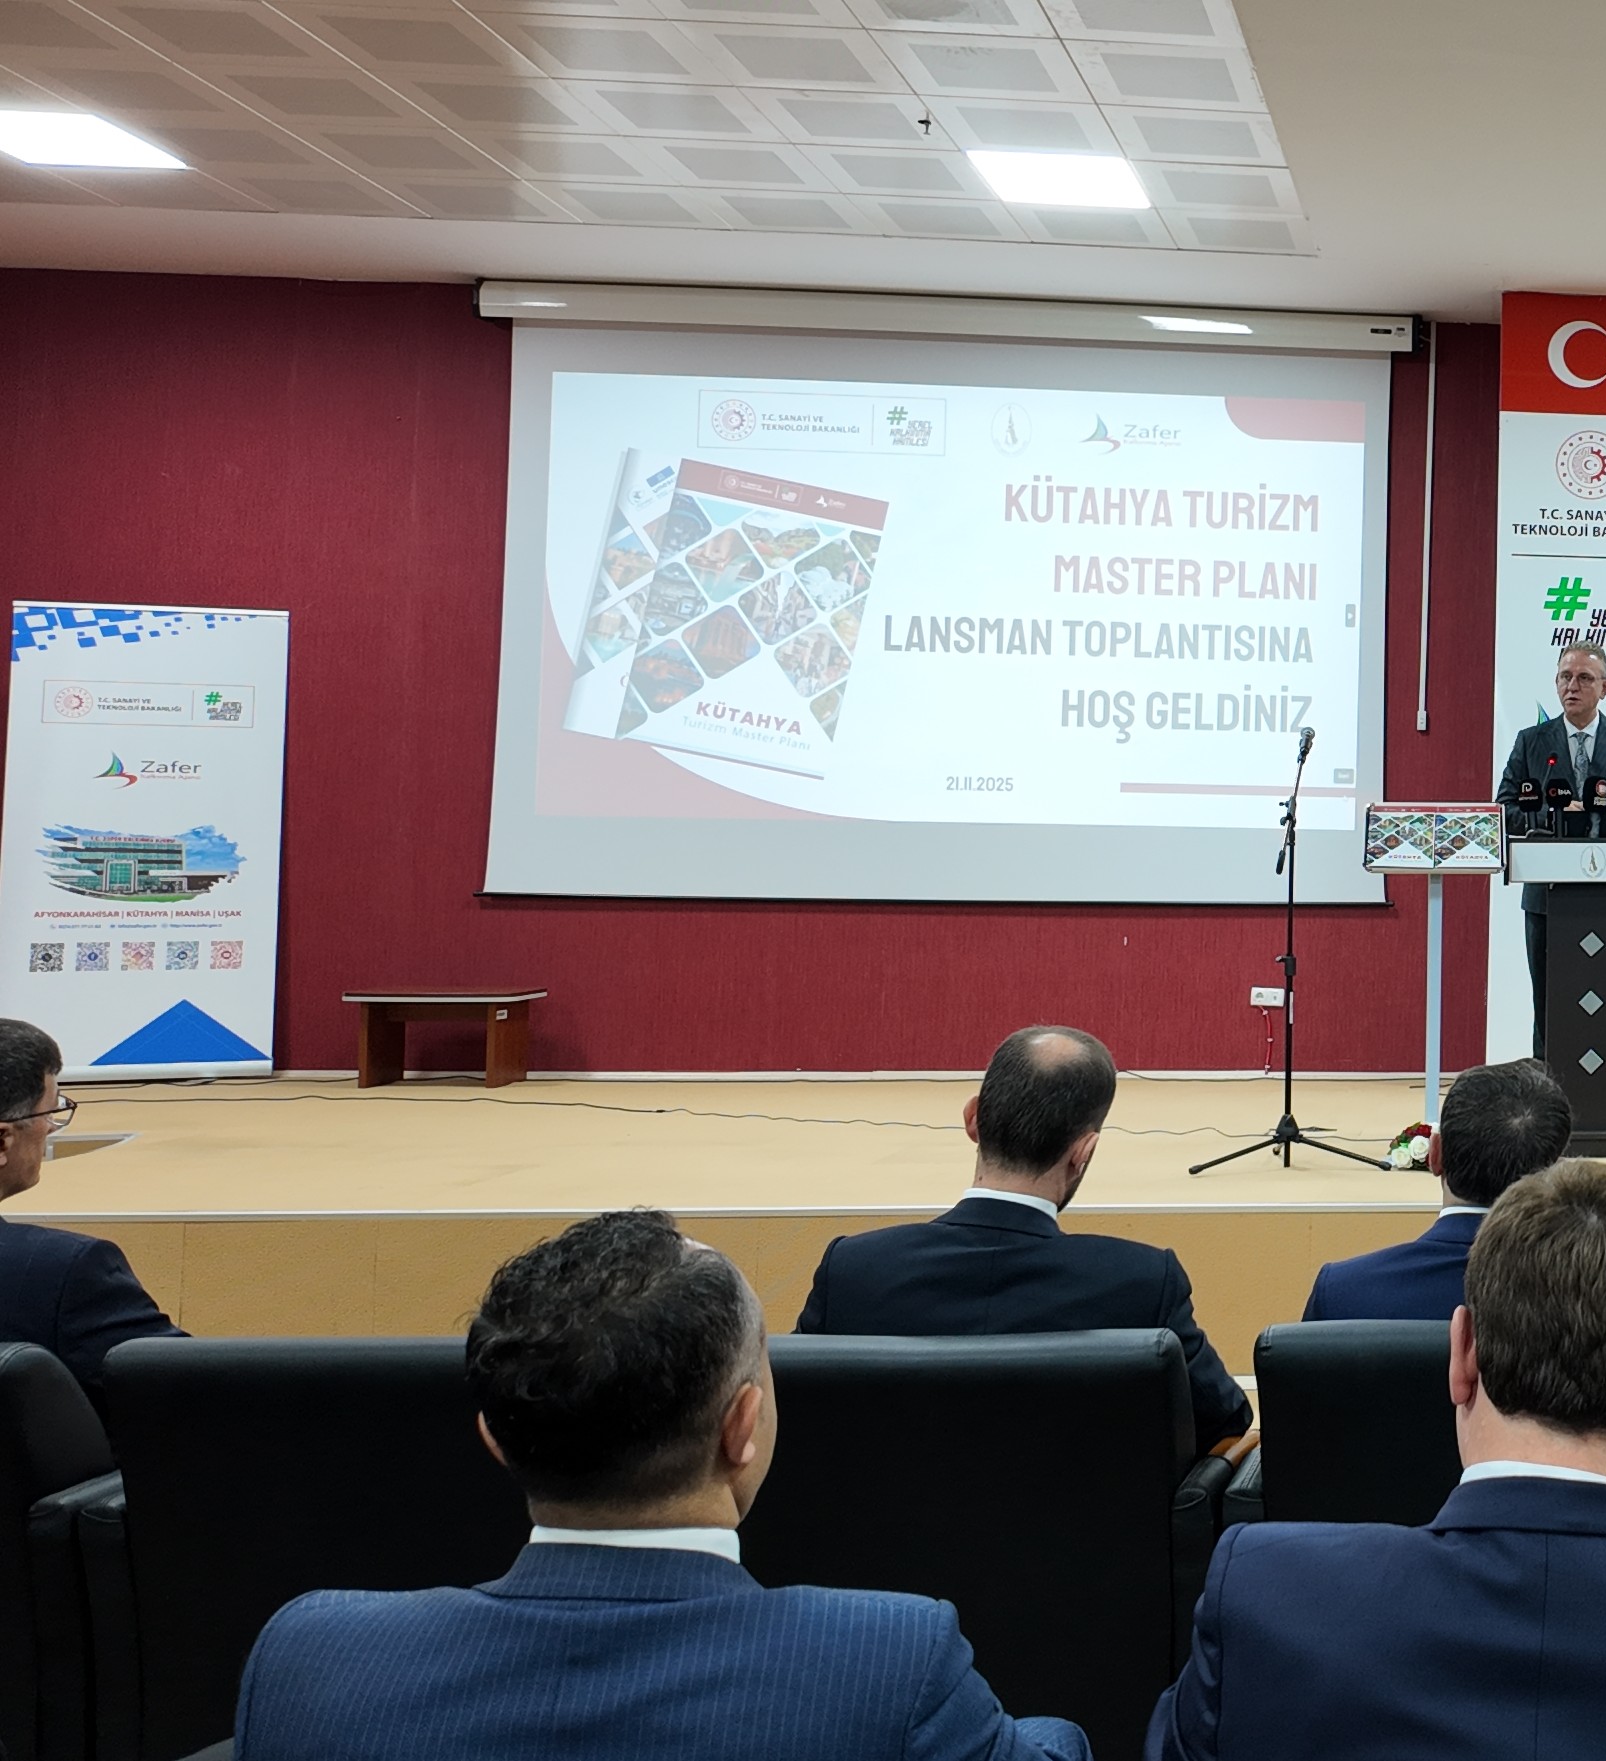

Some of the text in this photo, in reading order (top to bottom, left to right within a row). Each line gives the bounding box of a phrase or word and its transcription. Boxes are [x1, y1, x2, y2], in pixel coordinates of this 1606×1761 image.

[1123, 424, 1182, 440] Zafer
[1004, 474, 1319, 533] KÜTAHYA TURİZM
[1539, 508, 1563, 520] T.C.
[1511, 523, 1588, 537] TEKNOLOJİ
[1053, 555, 1318, 601] MASTER PLANI
[883, 614, 1314, 664] LANSMAN TOPLANTISINA
[695, 700, 802, 736] KÜTAHYA
[1060, 684, 1313, 744] HOŞ GELDİNİZ
[681, 716, 727, 735] Turizm
[731, 726, 776, 745] Master
[140, 760, 202, 774] Zafer
[945, 775, 1014, 792] 21.11.2025
